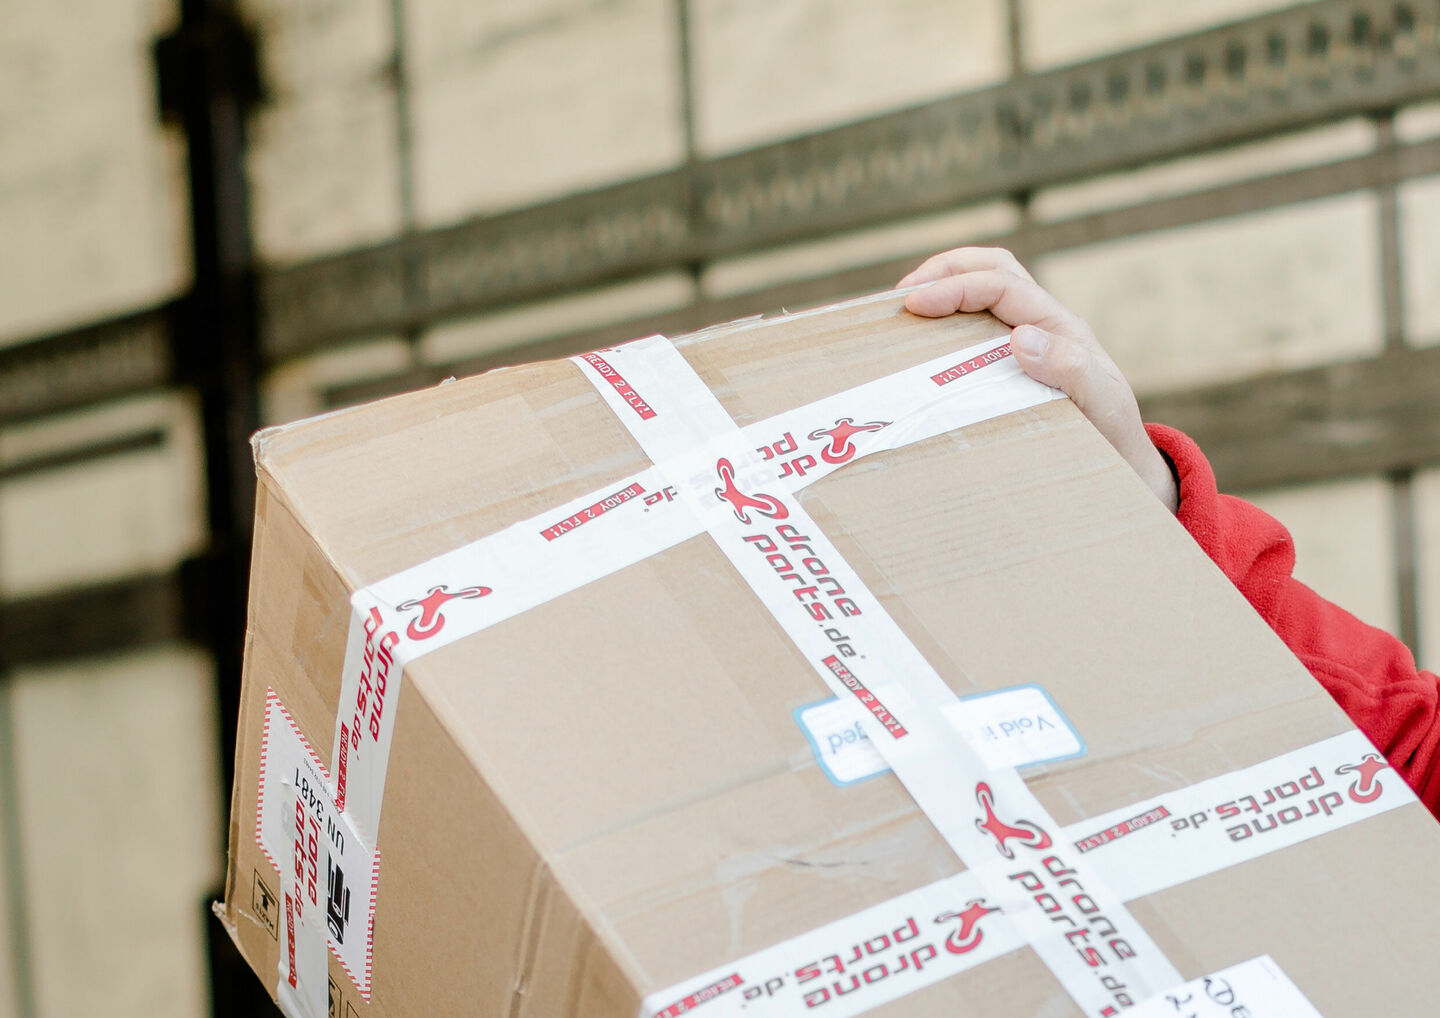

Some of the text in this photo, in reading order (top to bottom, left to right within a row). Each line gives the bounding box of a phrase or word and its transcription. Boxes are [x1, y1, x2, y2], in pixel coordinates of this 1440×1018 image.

[586, 354, 650, 413] READY 2 FLY!
[550, 516, 581, 537] FLY!
[584, 508, 596, 518] 2
[600, 487, 636, 511] READY
[742, 534, 857, 659] parts.de
[775, 524, 862, 617] drone
[351, 606, 383, 751] parts.de
[369, 631, 400, 742] drone
[829, 660, 901, 731] READY 2 FLY!
[339, 731, 348, 767] READY
[999, 715, 1055, 738] Void
[295, 767, 324, 823] 3481
[1171, 766, 1325, 832] parts.de
[1226, 790, 1345, 843] drone
[295, 795, 307, 919] arts.de
[327, 815, 344, 856] UN
[1007, 870, 1134, 1007] parts.de
[1042, 855, 1137, 961] drone
[743, 917, 920, 1002] parts.de
[803, 943, 937, 1010] drone
